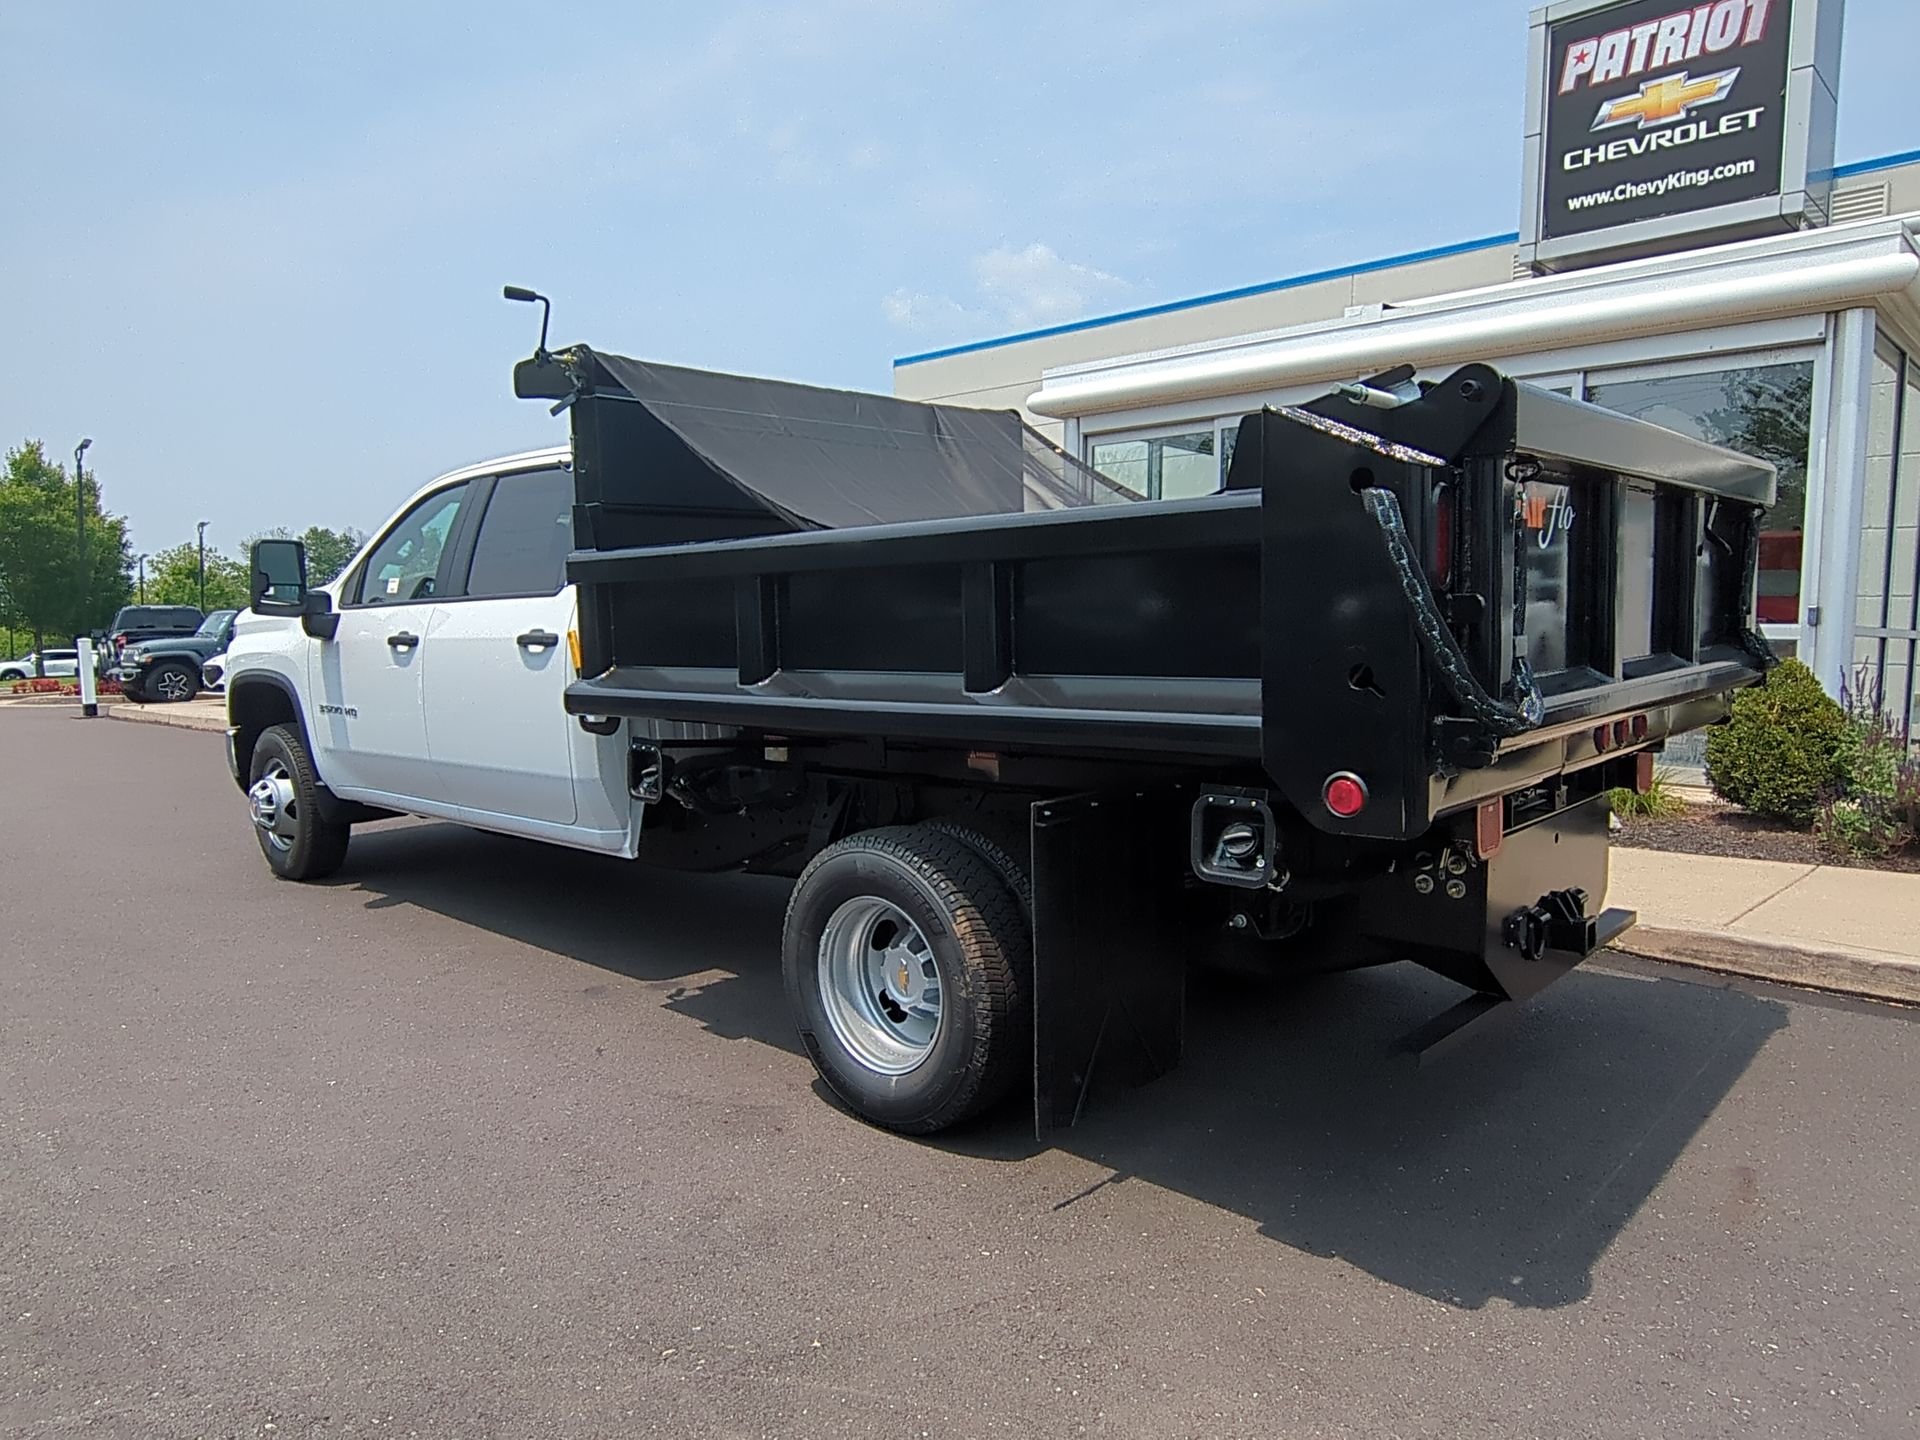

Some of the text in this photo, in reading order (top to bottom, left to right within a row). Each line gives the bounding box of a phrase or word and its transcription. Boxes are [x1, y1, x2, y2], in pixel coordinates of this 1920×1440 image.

[1559, 0, 1773, 95] PATRIOT
[1563, 107, 1765, 171] CHEVROLET
[1567, 158, 1755, 211] www.ChevyKing.com
